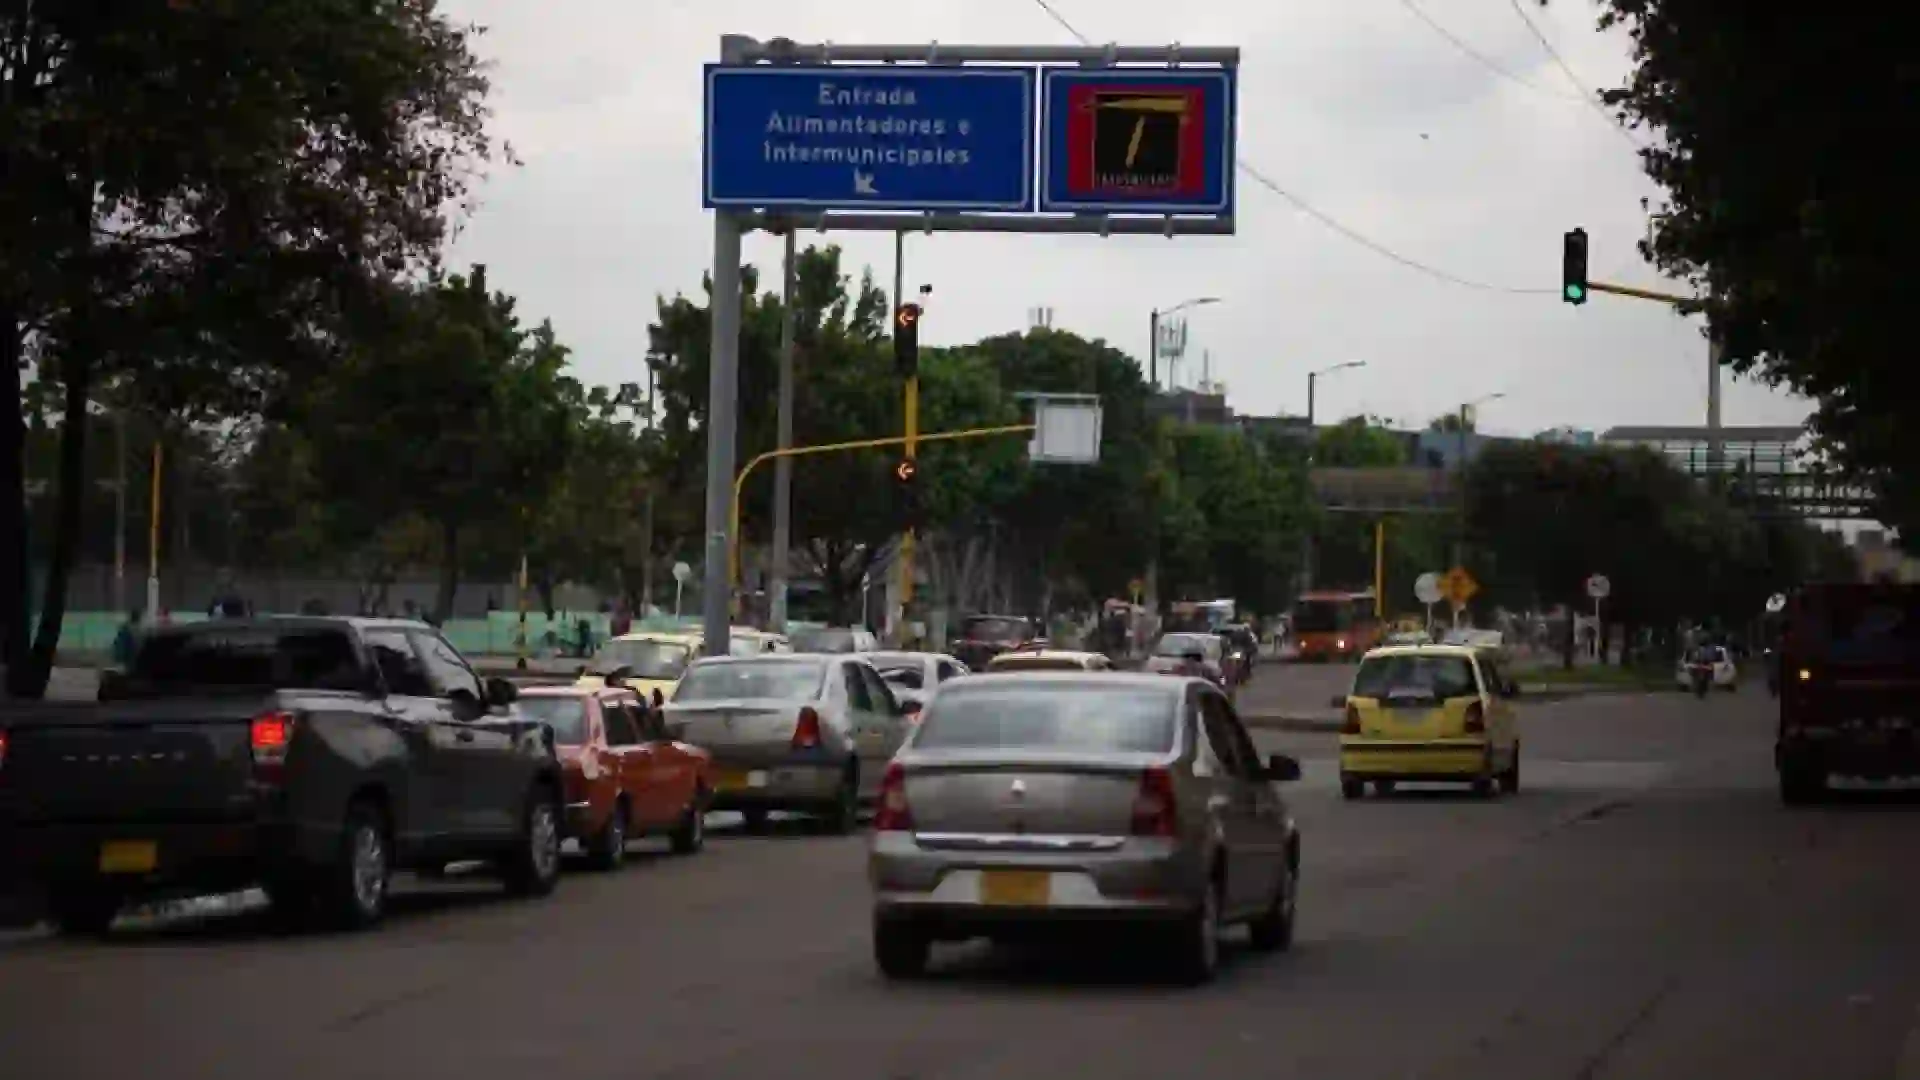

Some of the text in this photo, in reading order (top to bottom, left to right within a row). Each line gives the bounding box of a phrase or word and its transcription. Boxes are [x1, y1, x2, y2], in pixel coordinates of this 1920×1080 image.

[818, 83, 917, 105] Entrada
[766, 111, 971, 136] Alimentadores e
[764, 141, 970, 166] Intermunicipales
